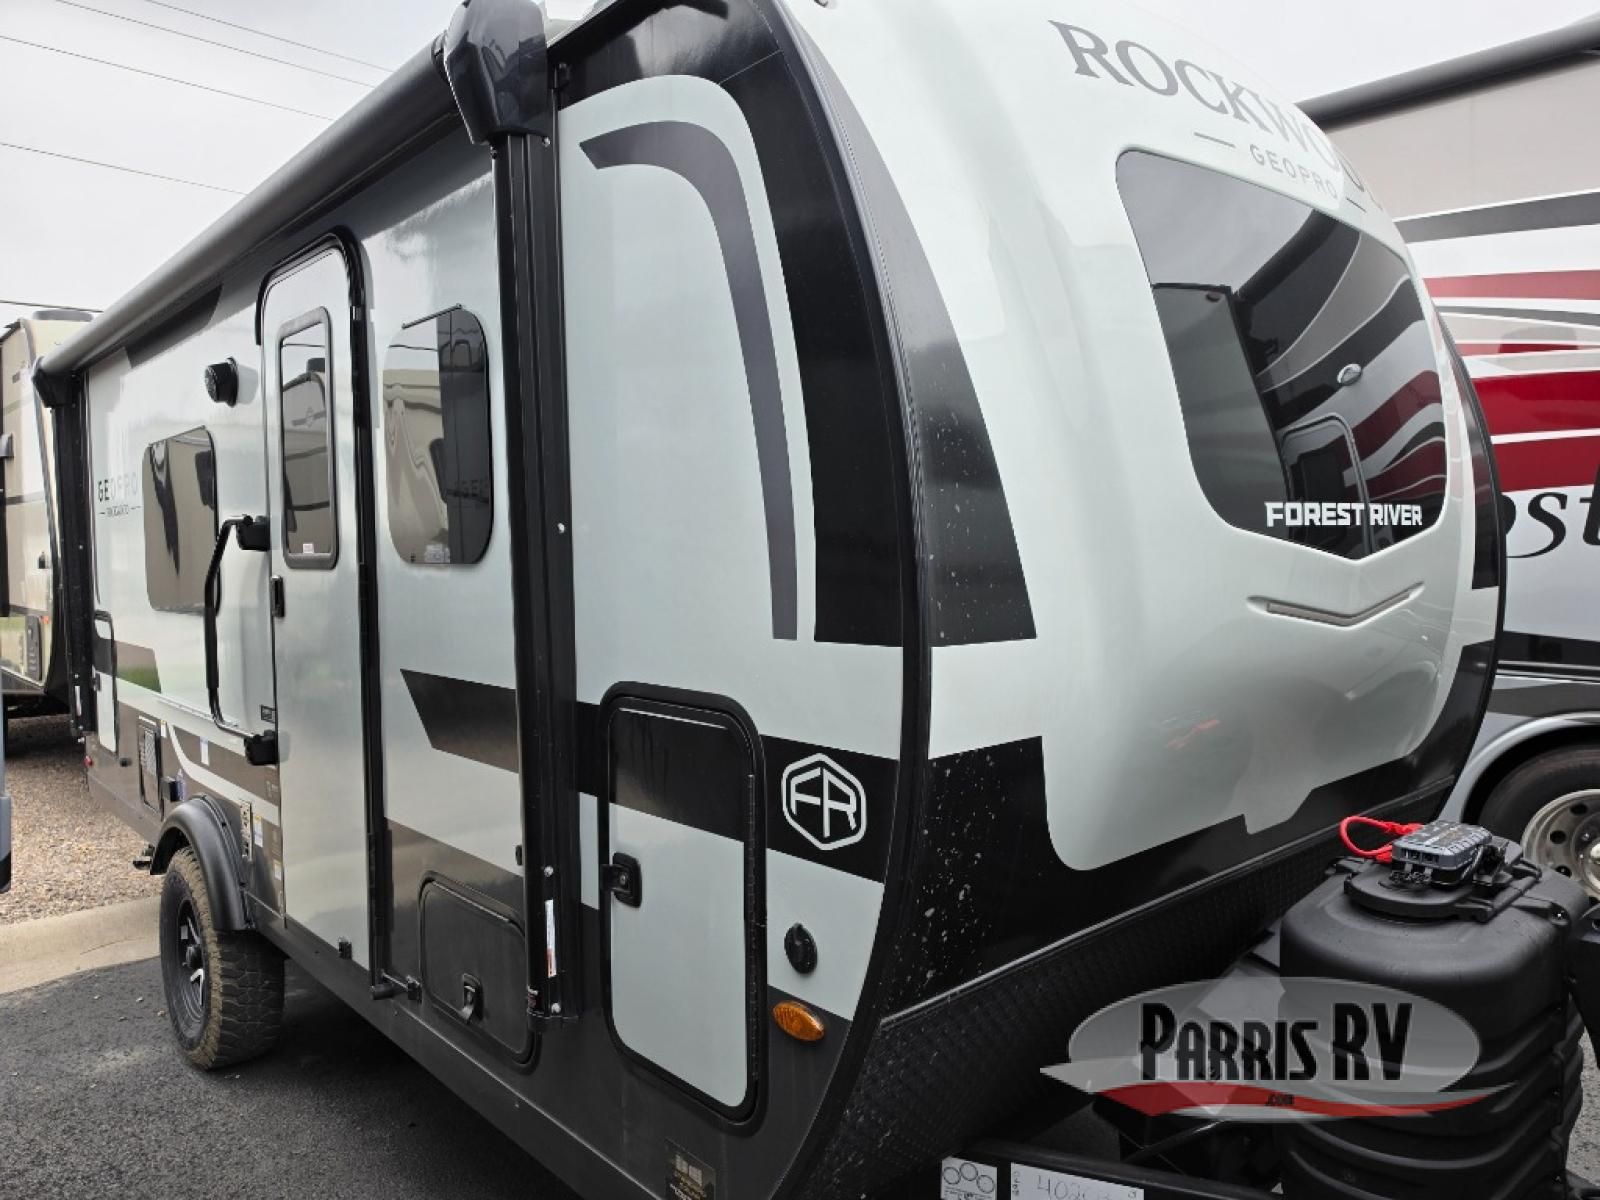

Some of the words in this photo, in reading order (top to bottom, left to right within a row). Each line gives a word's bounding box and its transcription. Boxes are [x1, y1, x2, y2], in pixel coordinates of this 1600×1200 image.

[1249, 143, 1338, 200] GEOPRO
[1264, 501, 1365, 528] FOREST
[1369, 502, 1423, 526] RIVER
